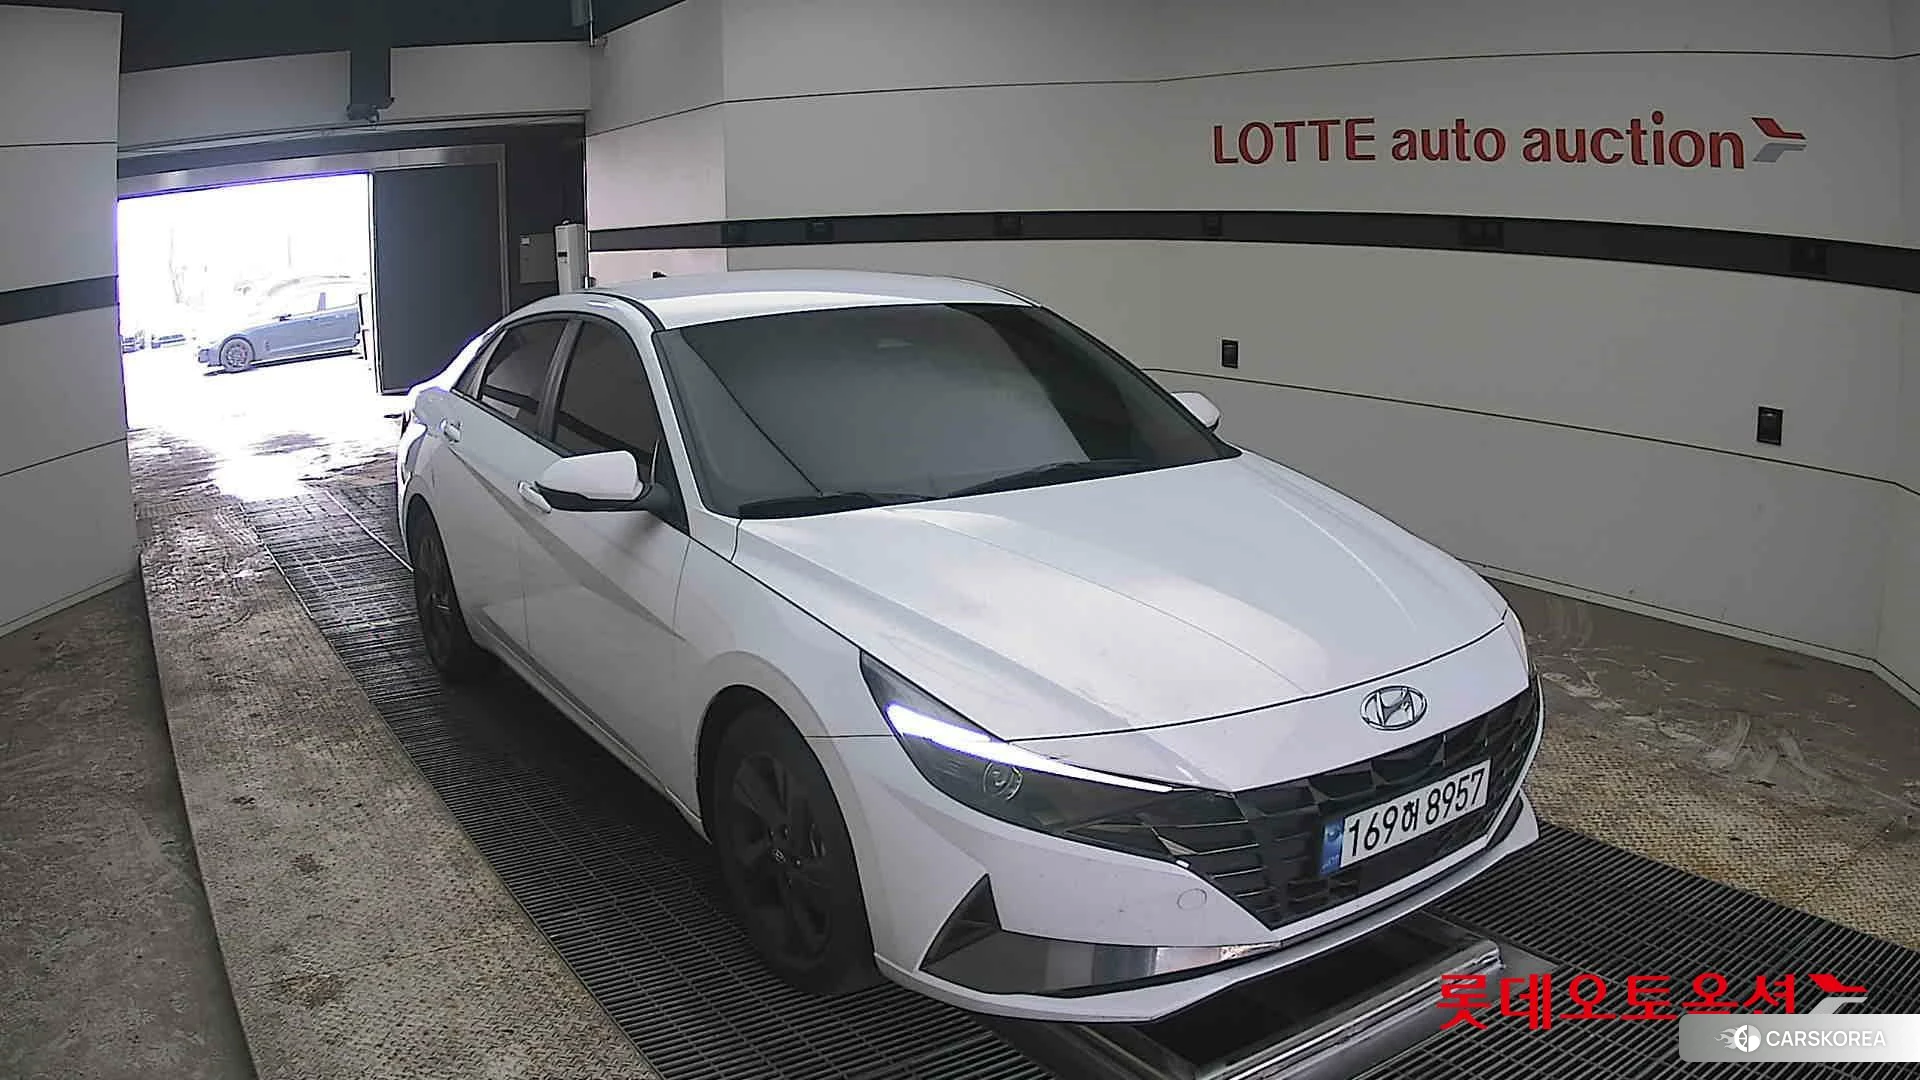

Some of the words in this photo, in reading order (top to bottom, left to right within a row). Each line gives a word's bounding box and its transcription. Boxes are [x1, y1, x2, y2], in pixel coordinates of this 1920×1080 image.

[1212, 118, 1376, 164] LOTTE
[1391, 118, 1506, 162] auto
[1522, 111, 1745, 169] auction
[1349, 798, 1420, 857] 169허
[1425, 767, 1486, 826] 8957
